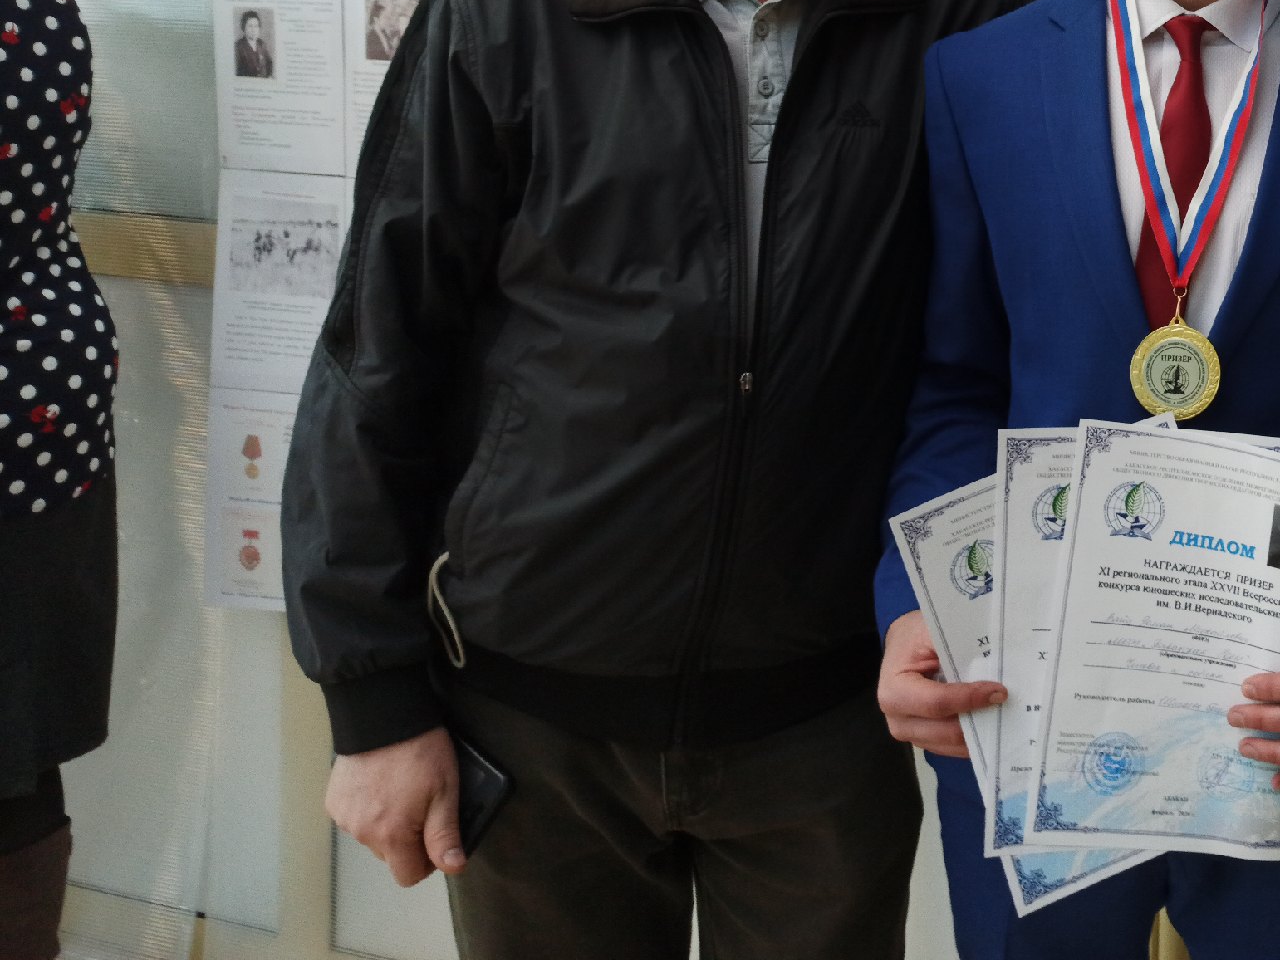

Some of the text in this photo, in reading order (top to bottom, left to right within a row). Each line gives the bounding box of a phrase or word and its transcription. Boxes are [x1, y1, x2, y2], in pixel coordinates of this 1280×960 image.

[1169, 530, 1256, 560] ДИПЛОМ
[1112, 569, 1181, 585] регионального
[1183, 579, 1208, 589] этапа
[1143, 558, 1274, 591] НАГРАЖДАЕТСЯ ПРИЗЕР
[1098, 581, 1141, 593] конкурса
[1142, 585, 1197, 600] юношеских
